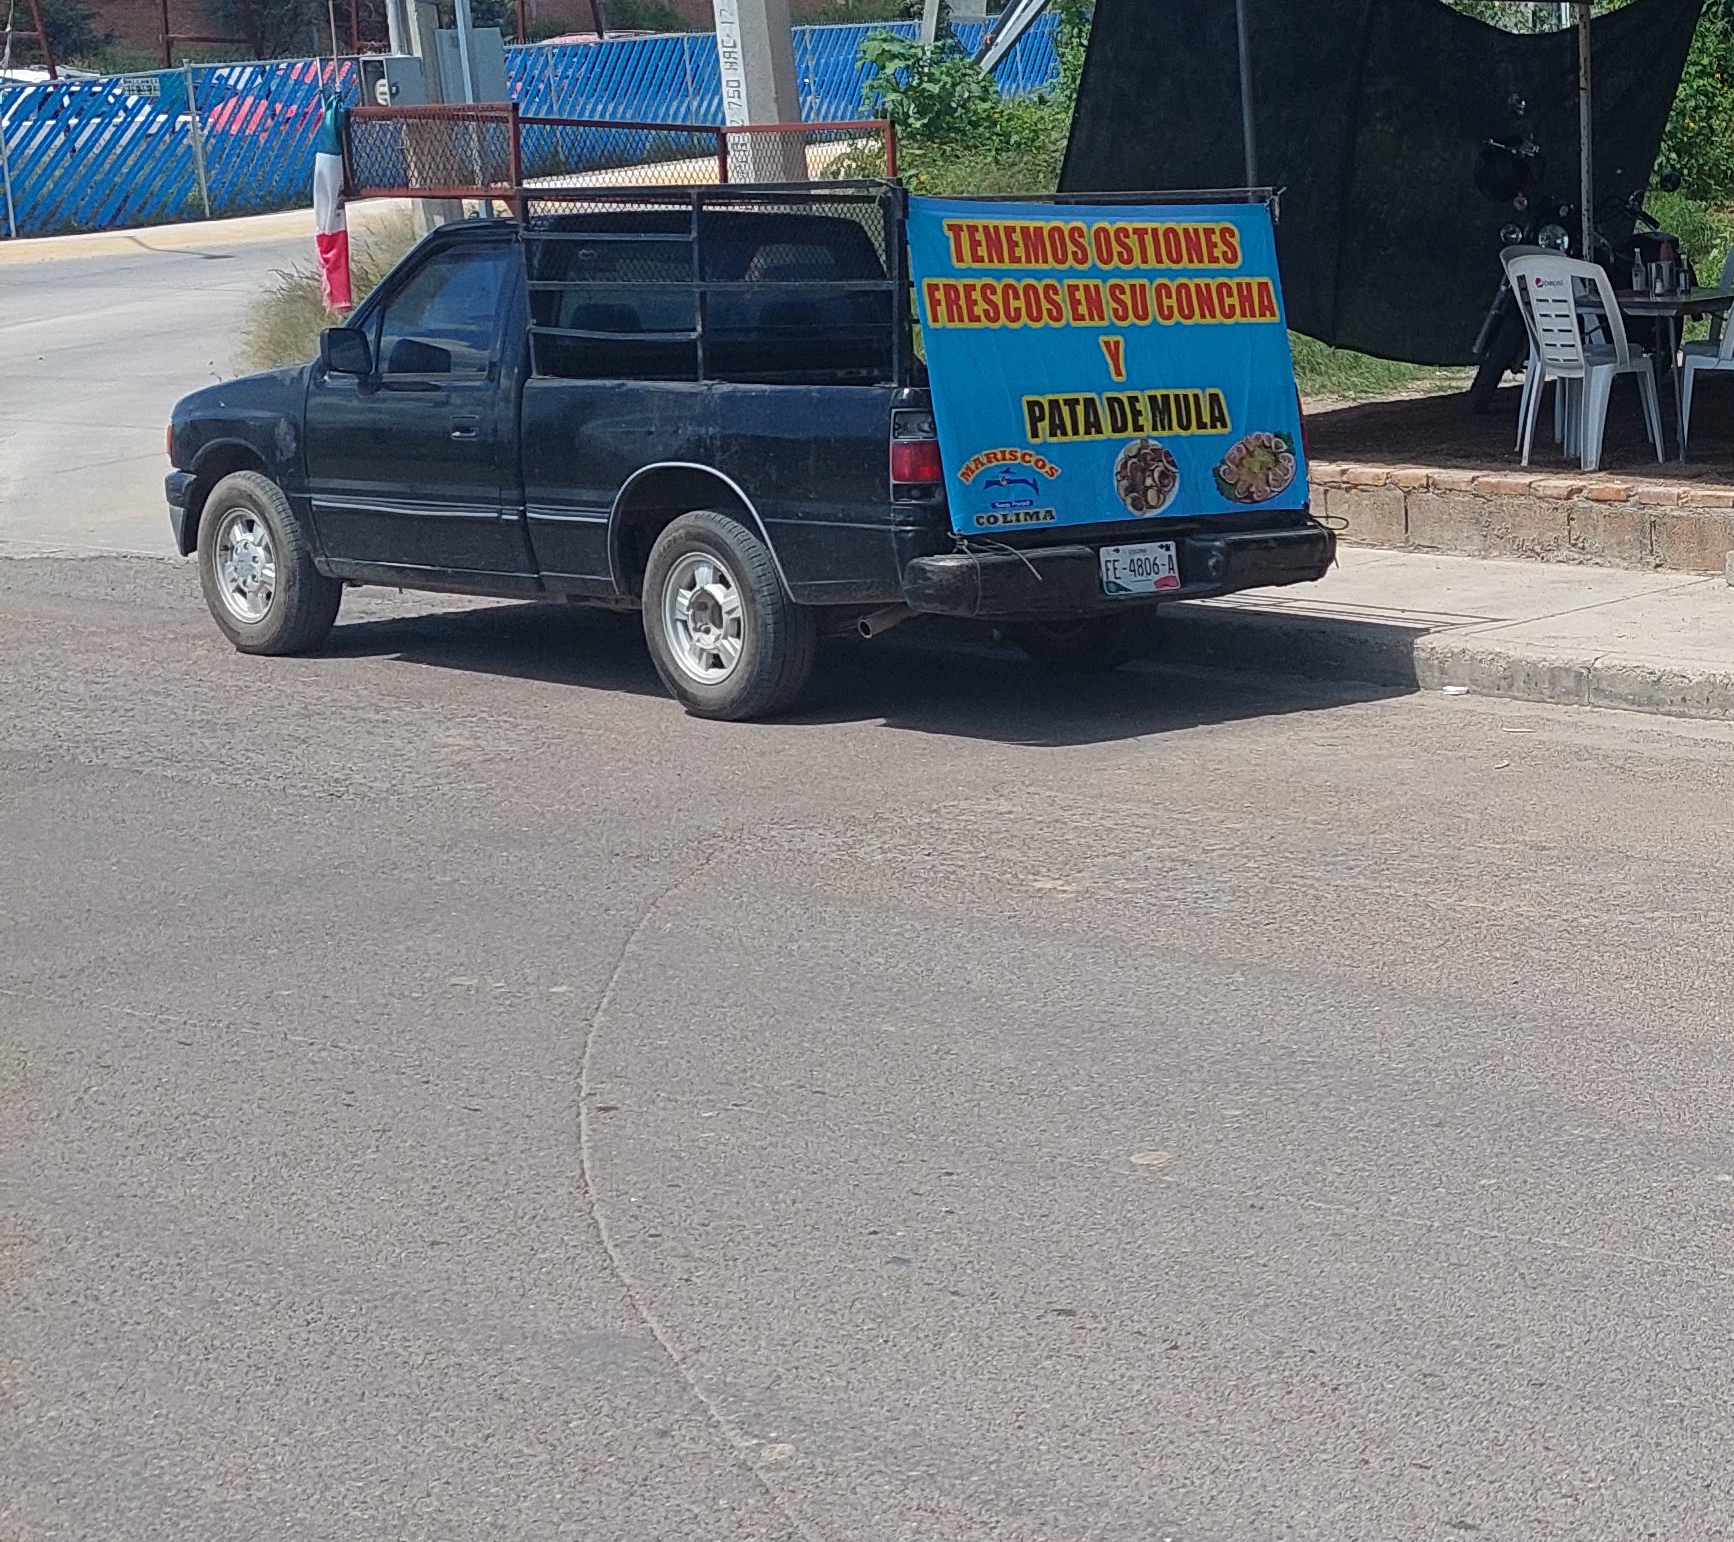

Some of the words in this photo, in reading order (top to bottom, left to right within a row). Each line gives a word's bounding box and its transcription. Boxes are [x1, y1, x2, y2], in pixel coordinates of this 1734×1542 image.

[945, 221, 1091, 267] TENEMOS
[1092, 224, 1241, 267] OSTIONES
[924, 280, 1066, 325] FRESCOS
[1067, 281, 1104, 324] EN
[1109, 281, 1151, 323] SU
[1153, 279, 1280, 323] CONCHA
[1099, 337, 1126, 380] Y
[1024, 395, 1104, 441] PATA
[1106, 394, 1145, 436] DE
[1146, 391, 1230, 432] MULA
[958, 448, 1061, 485] MARISCOS
[975, 508, 1057, 526] COLIMA
[1104, 554, 1177, 581] FE-4806-A
